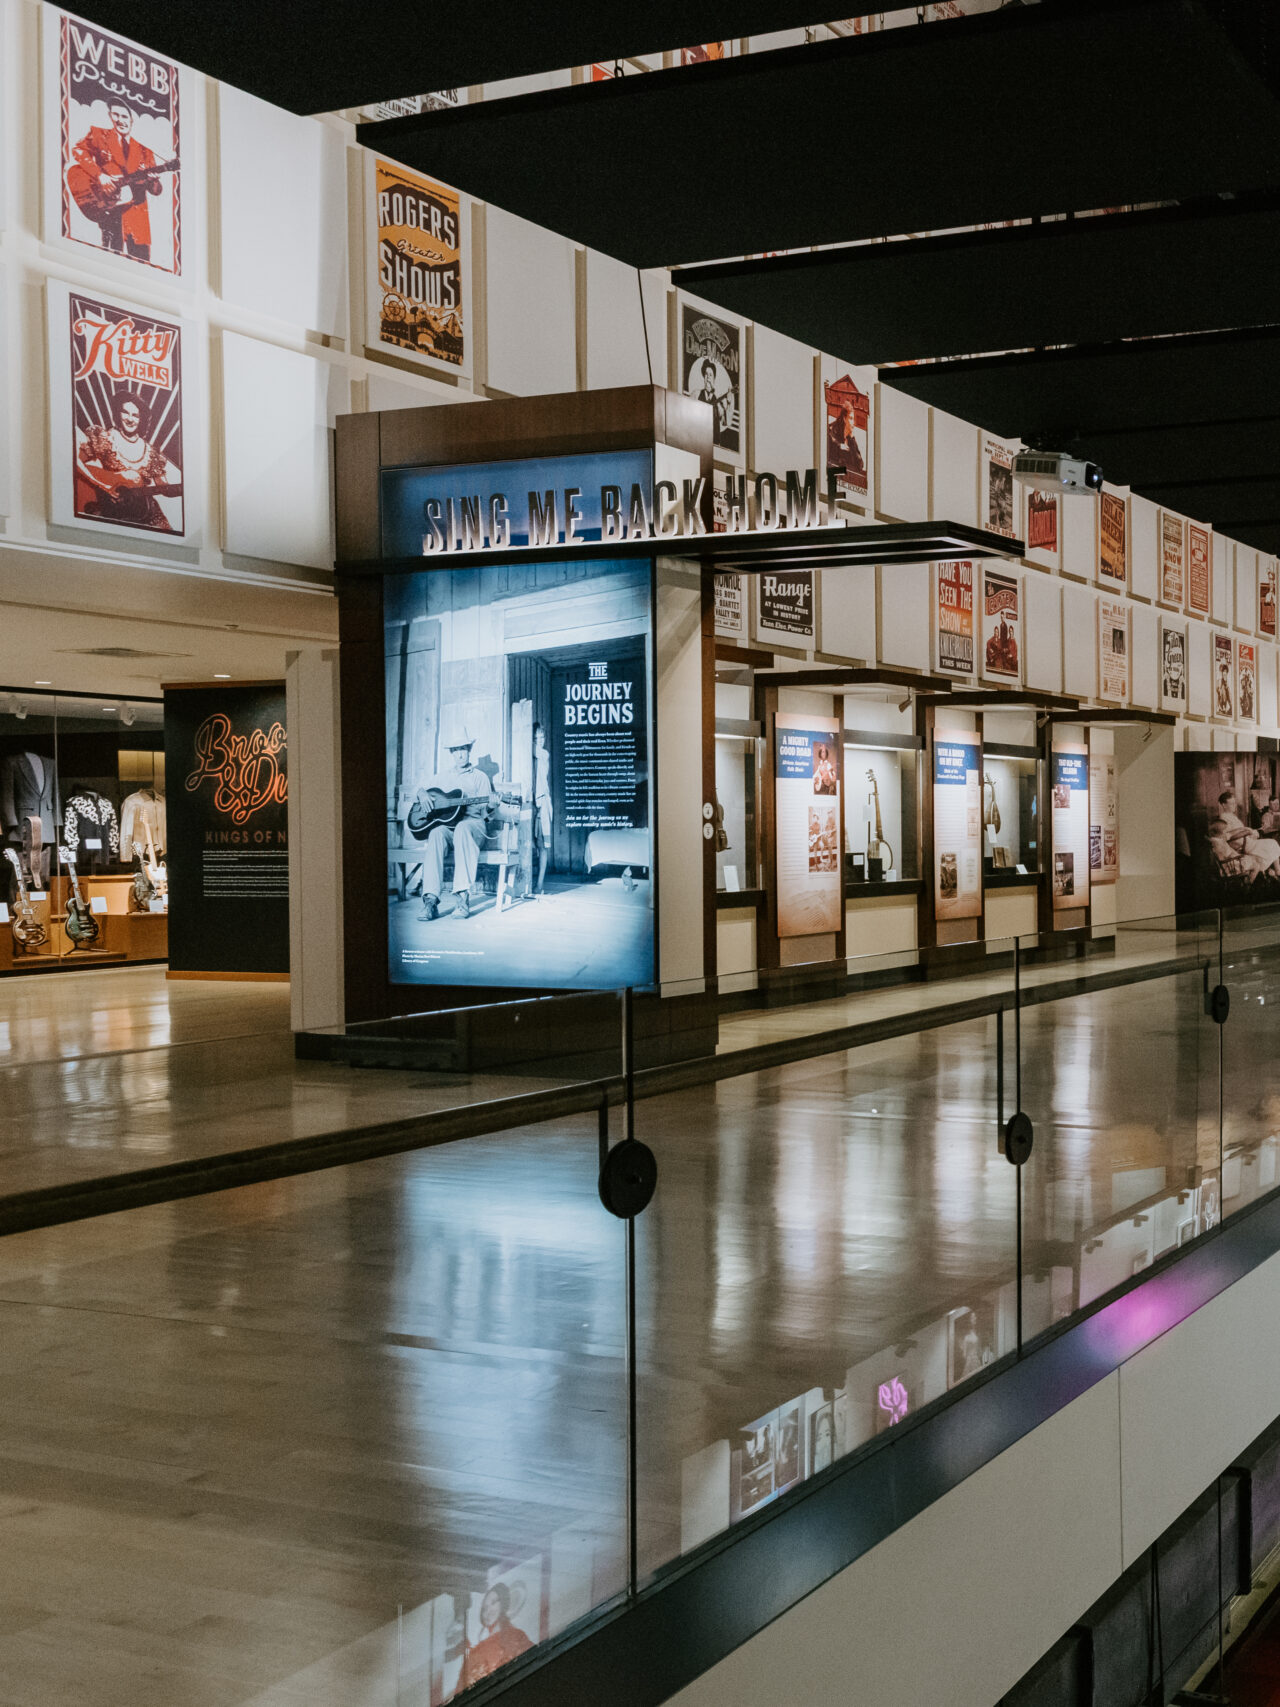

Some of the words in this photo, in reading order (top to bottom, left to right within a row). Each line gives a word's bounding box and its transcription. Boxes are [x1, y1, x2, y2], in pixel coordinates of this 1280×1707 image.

[70, 25, 169, 95] WEBB
[73, 61, 166, 113] Pierce
[378, 191, 457, 250] ROGERS
[396, 238, 447, 262] Greater
[379, 241, 458, 310] SHOWS
[74, 319, 170, 379] Kitty
[707, 340, 739, 374] MACON
[121, 358, 168, 386] WELLS
[422, 493, 510, 556] SING
[528, 487, 584, 546] ME
[600, 478, 708, 540] BACK
[725, 467, 847, 532] HOME
[939, 561, 956, 582] HAVE
[959, 561, 972, 586] YOU
[763, 576, 811, 606] Range
[940, 582, 957, 606] SEEN
[960, 587, 972, 610] THE
[773, 602, 793, 611] LOWEST
[780, 612, 801, 620] HISTORY
[940, 607, 961, 632] SHOW
[589, 665, 607, 677] THE
[942, 658, 954, 667] THIS
[956, 660, 972, 670] WEEK
[564, 682, 632, 702] JOURNEY
[564, 703, 633, 726] BEGINS
[780, 746, 795, 756] GOOD
[796, 747, 811, 757] ROAD
[782, 735, 787, 745] A
[787, 736, 809, 746] MIGHTY
[205, 830, 249, 843] KINGS
[254, 830, 272, 843] OF
